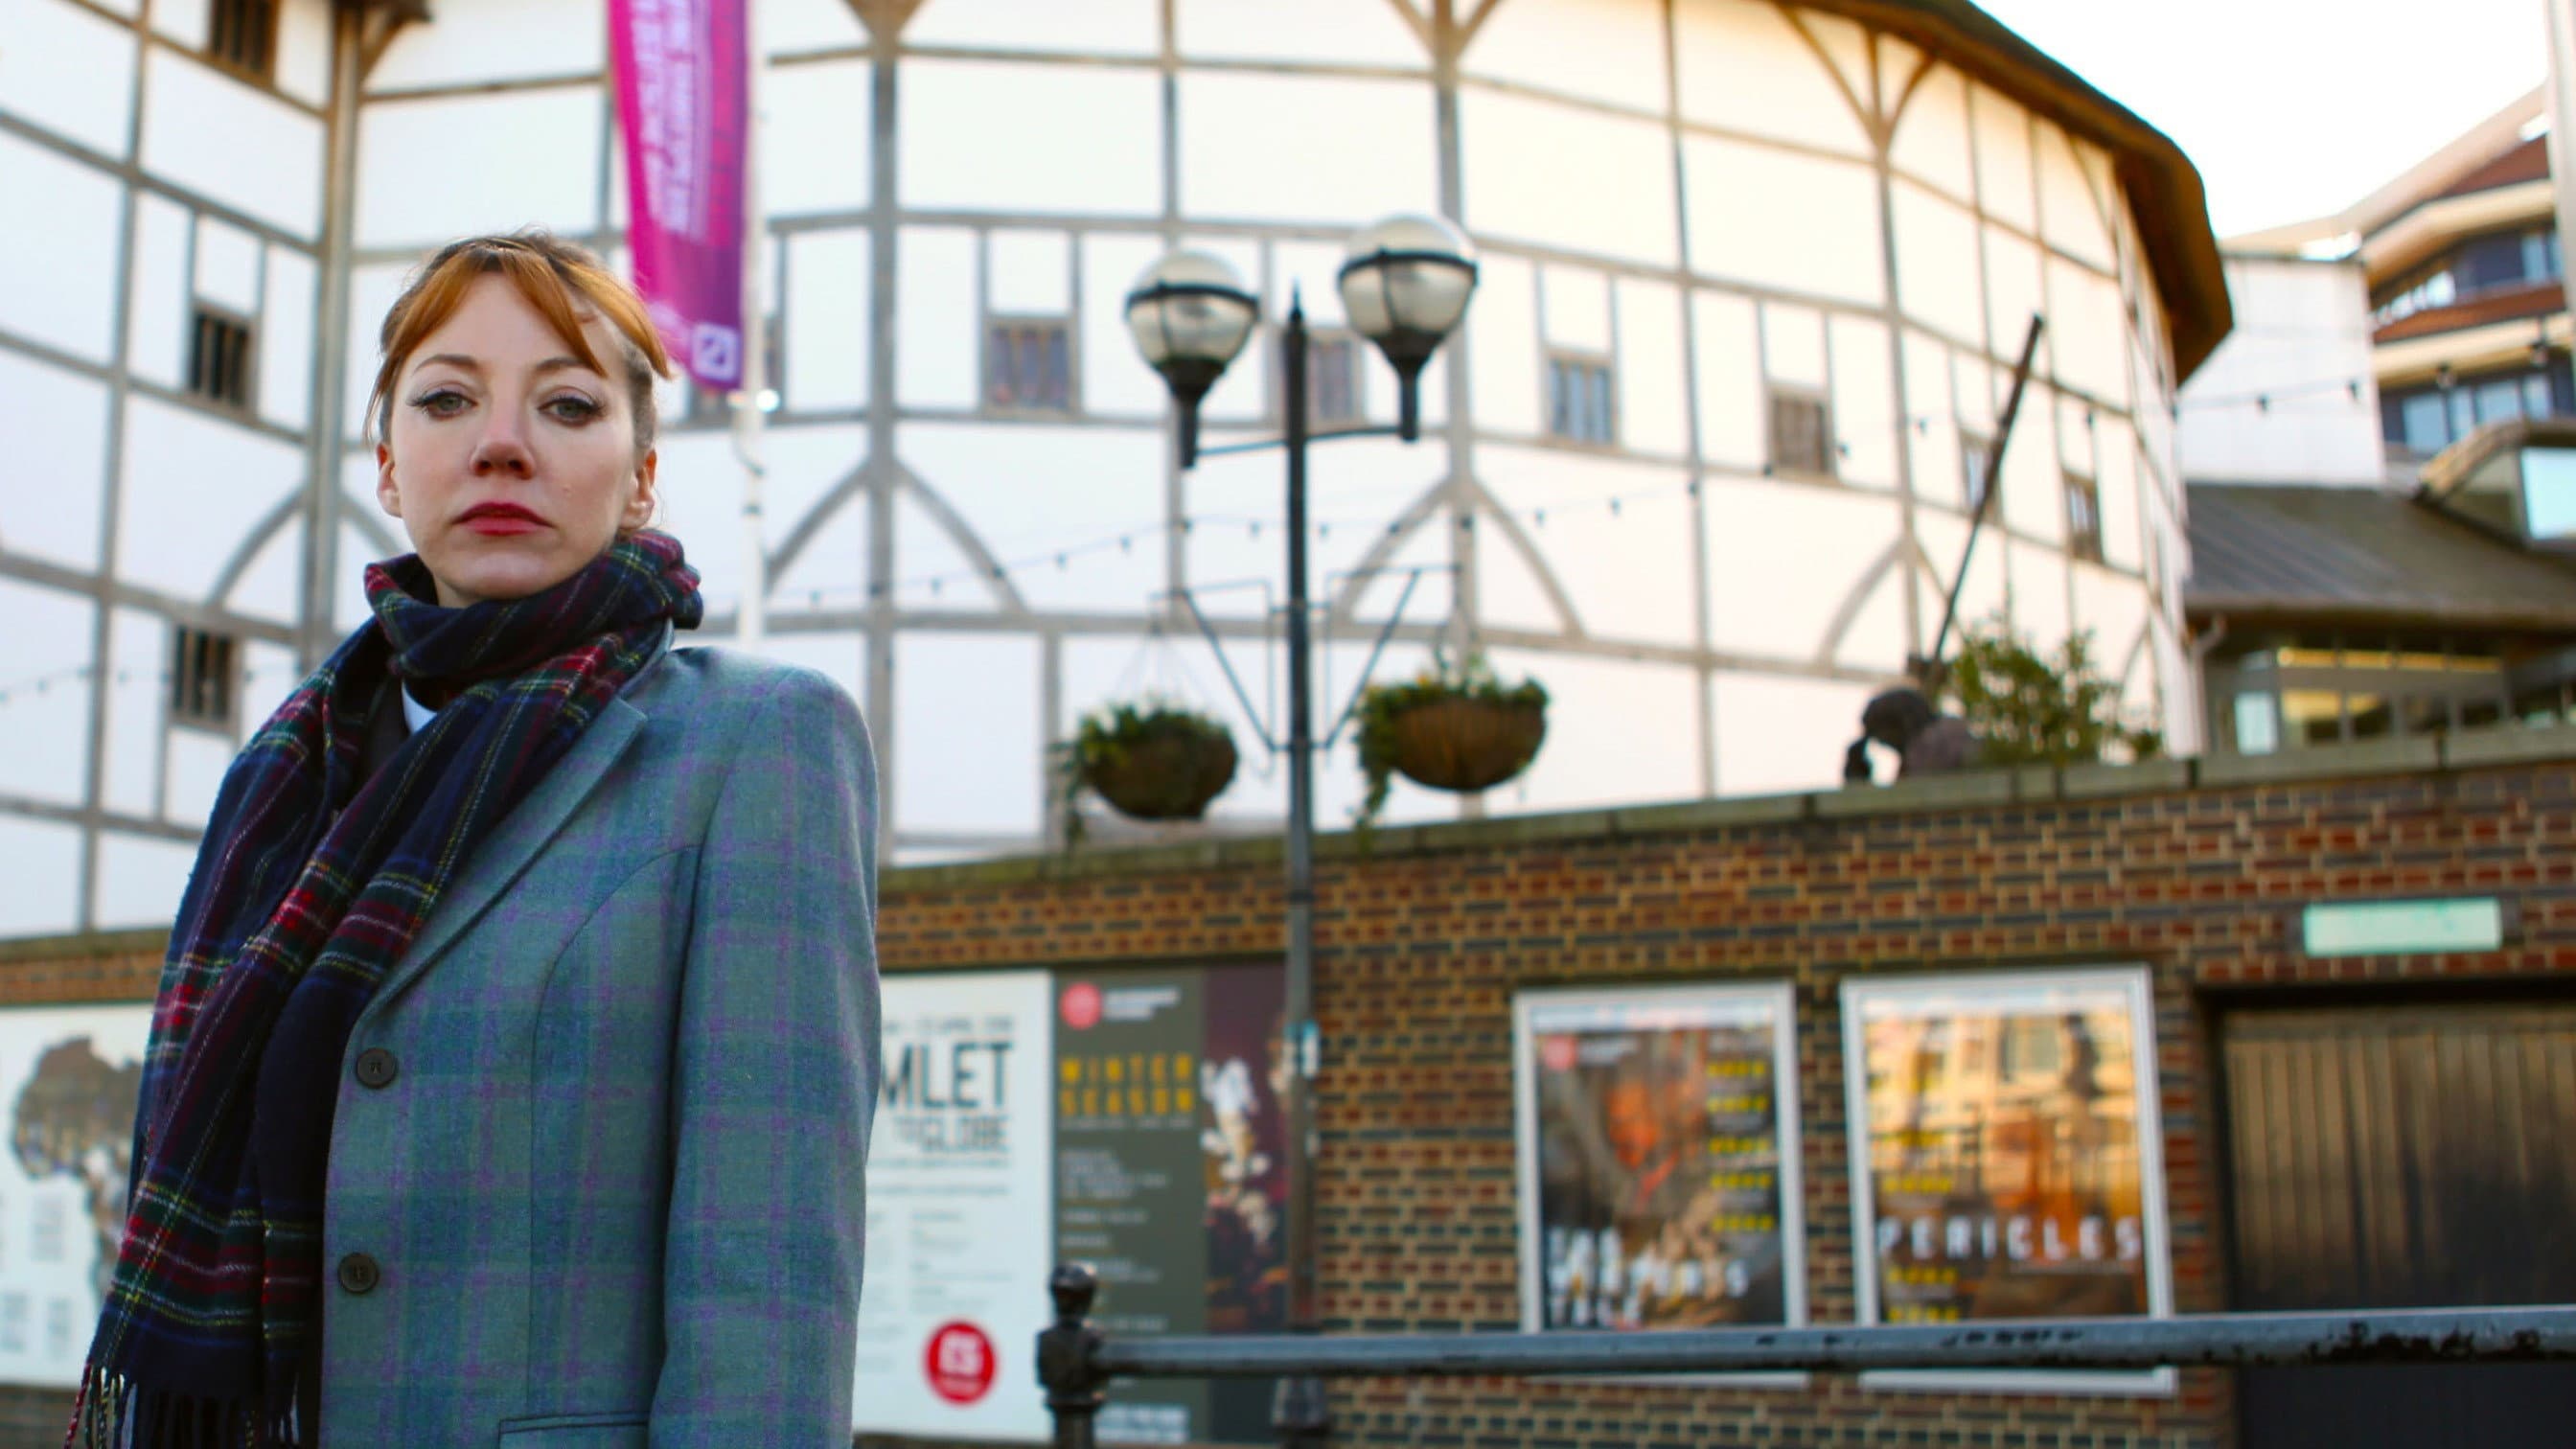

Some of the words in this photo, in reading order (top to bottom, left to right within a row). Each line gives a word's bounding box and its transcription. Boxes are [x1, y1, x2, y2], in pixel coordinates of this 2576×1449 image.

[1060, 1054, 1192, 1085] WINTER
[1060, 1087, 1194, 1117] SEASON
[1875, 1215, 2142, 1260] PERICLES
